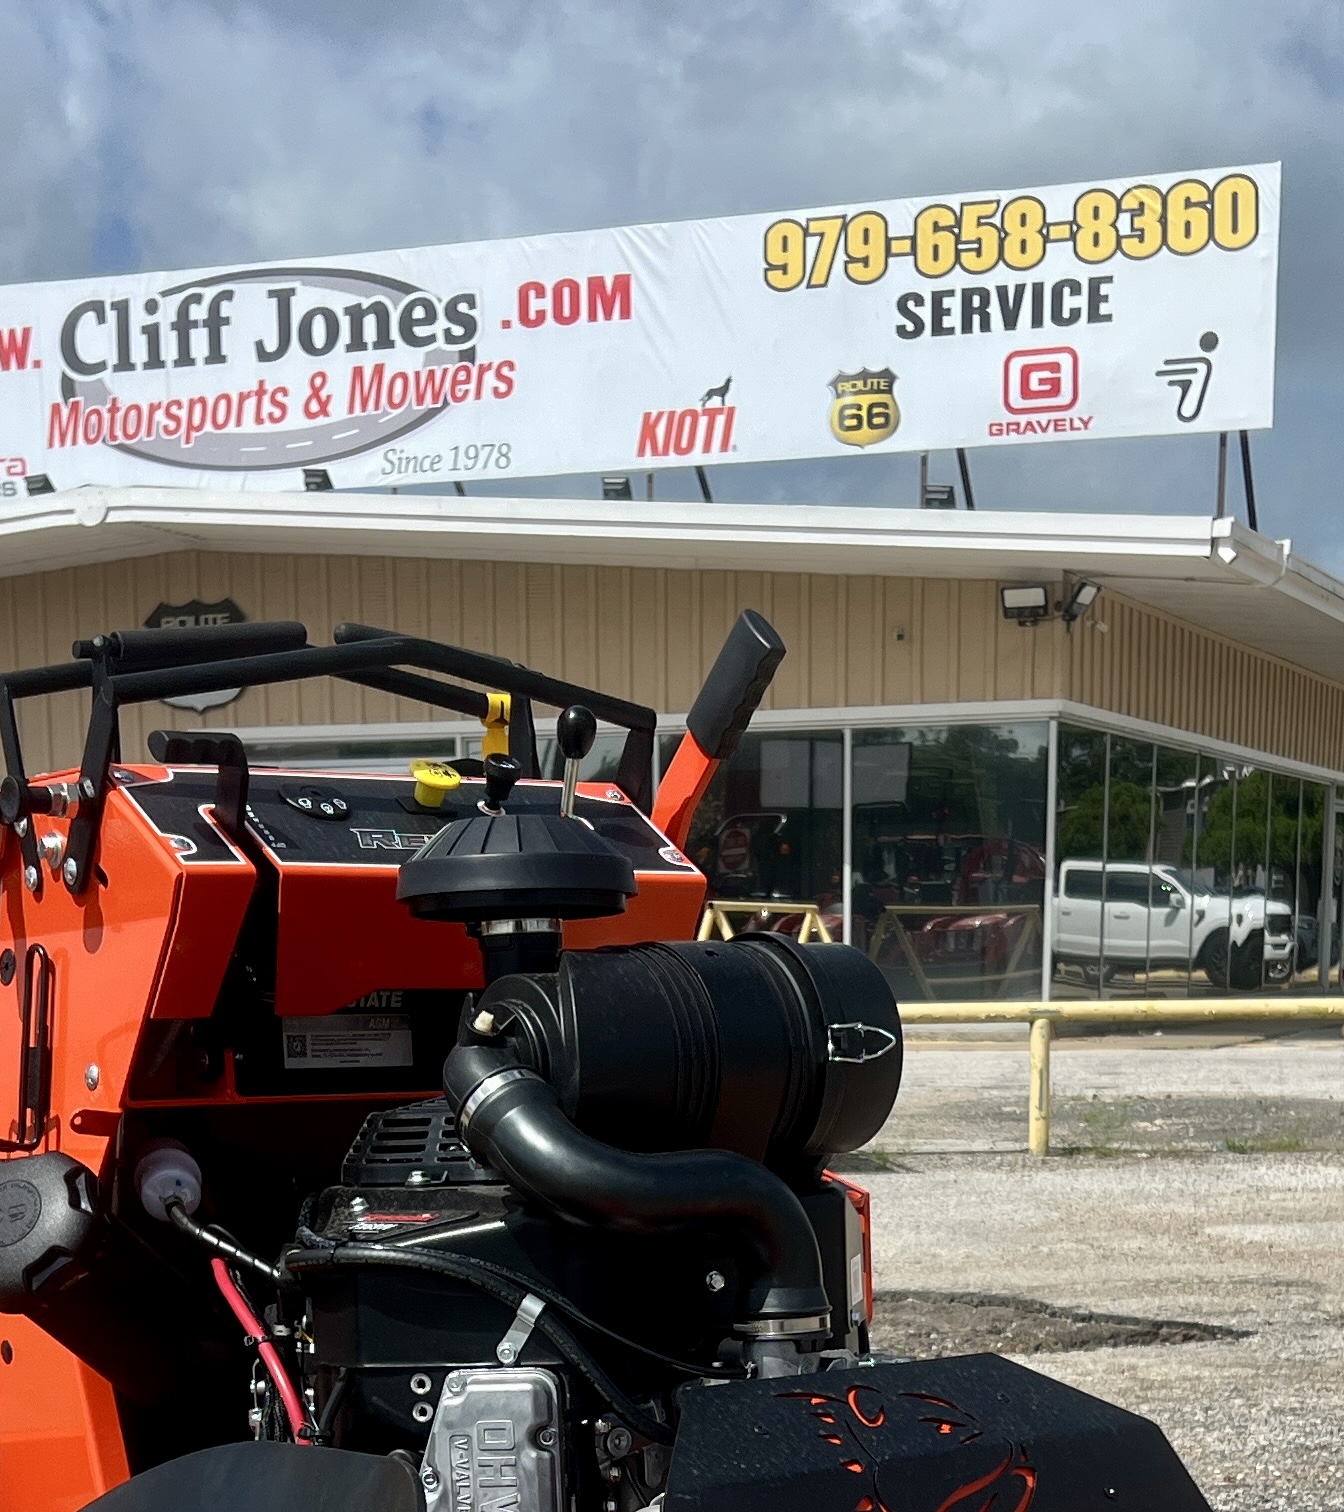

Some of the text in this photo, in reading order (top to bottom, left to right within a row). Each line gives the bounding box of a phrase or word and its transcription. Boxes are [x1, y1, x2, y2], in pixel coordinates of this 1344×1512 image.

[764, 172, 1260, 292] 979-658-8360
[60, 289, 233, 376] Cliff
[256, 287, 478, 363] Jones
[501, 273, 632, 330] .COM
[895, 275, 1114, 339] SERVICE
[47, 359, 516, 449] Motorsports & Mowers
[838, 378, 889, 393] ROUTE
[635, 406, 736, 457] KIOTI
[838, 401, 891, 432] 66
[988, 416, 1094, 437] GRAVELY
[381, 443, 513, 476] Since 1978
